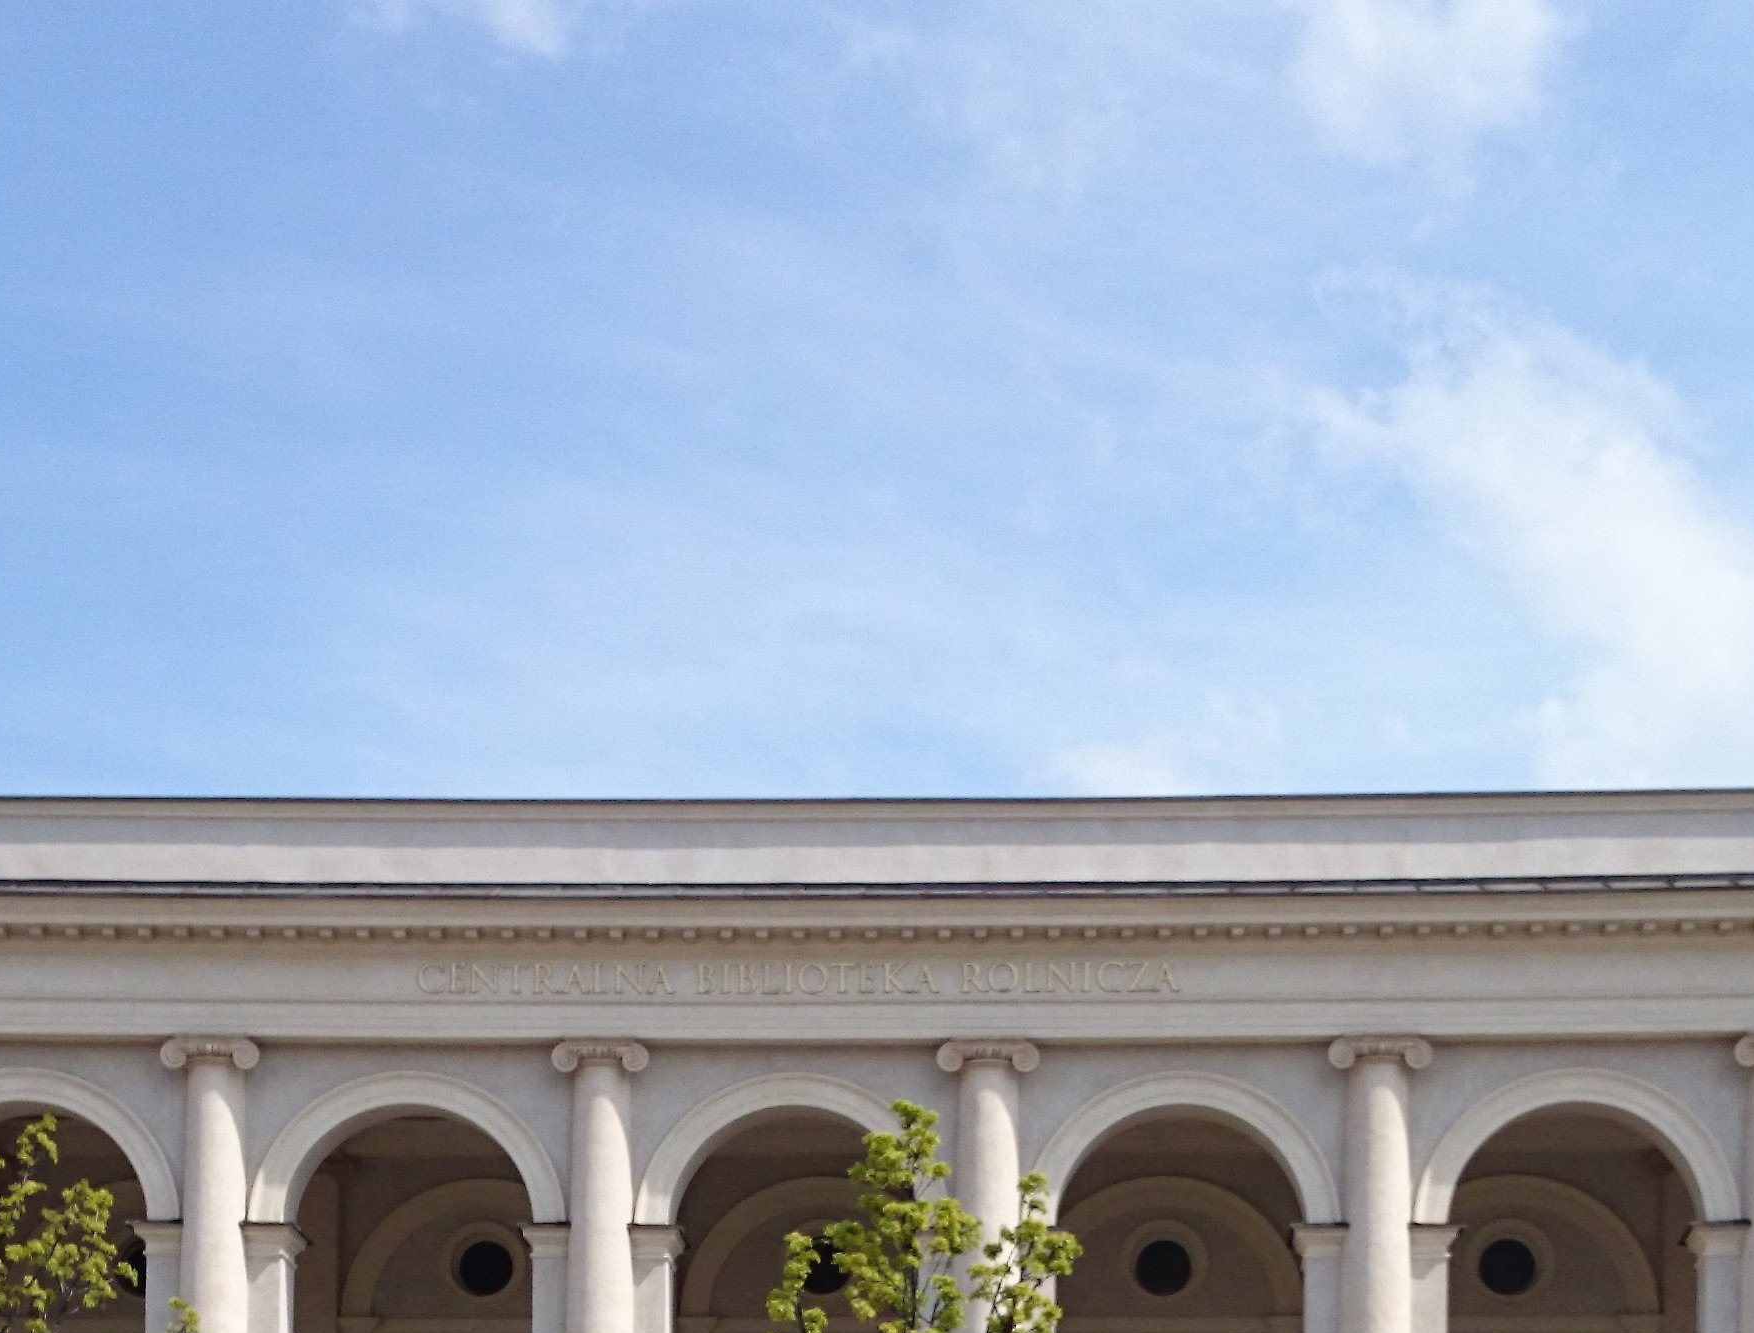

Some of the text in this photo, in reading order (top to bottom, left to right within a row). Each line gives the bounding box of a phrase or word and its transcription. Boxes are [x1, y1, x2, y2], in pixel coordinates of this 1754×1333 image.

[416, 960, 1182, 995] CENTRALNA BIBLIOTEKA ROLNICZA
